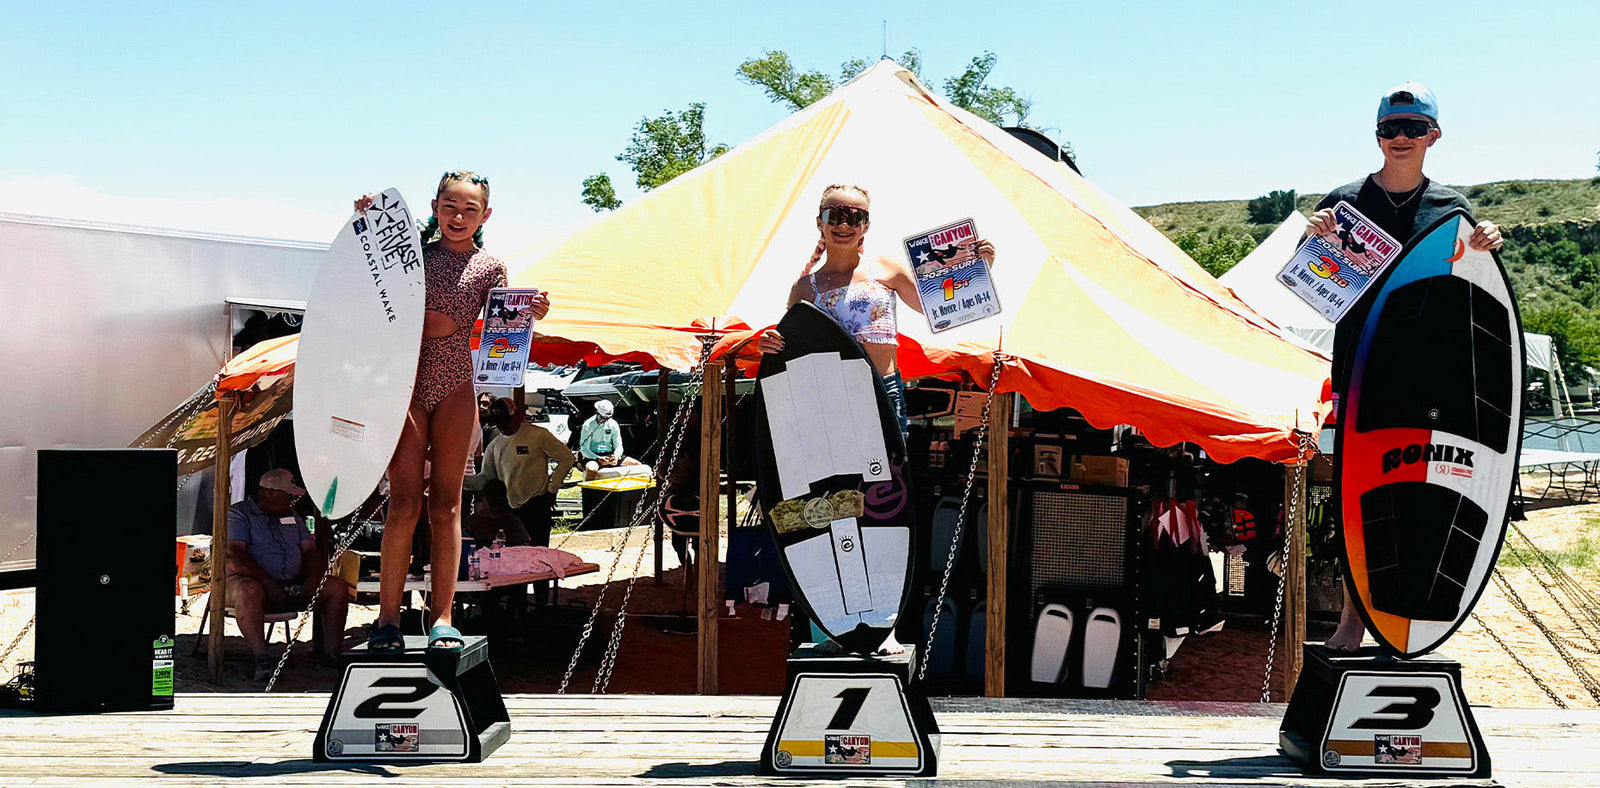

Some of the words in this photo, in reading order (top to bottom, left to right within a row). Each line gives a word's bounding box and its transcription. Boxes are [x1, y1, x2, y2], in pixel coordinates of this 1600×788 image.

[376, 225, 399, 263] FIVE
[389, 220, 421, 275] PHASE
[908, 237, 929, 248] WAKE
[934, 224, 971, 246] CANYON
[1340, 208, 1358, 225] WAKE
[1356, 225, 1393, 256] CANYON
[360, 235, 382, 287] COASTAL
[380, 289, 396, 323] WAKE
[974, 291, 991, 304] 10-14
[1327, 293, 1345, 309] 10-14
[1382, 443, 1475, 475] RONIX
[353, 677, 440, 719] 2
[825, 687, 872, 730] 1
[1347, 685, 1441, 729] 3
[392, 725, 418, 734] CANYON
[843, 736, 869, 746] CANYON
